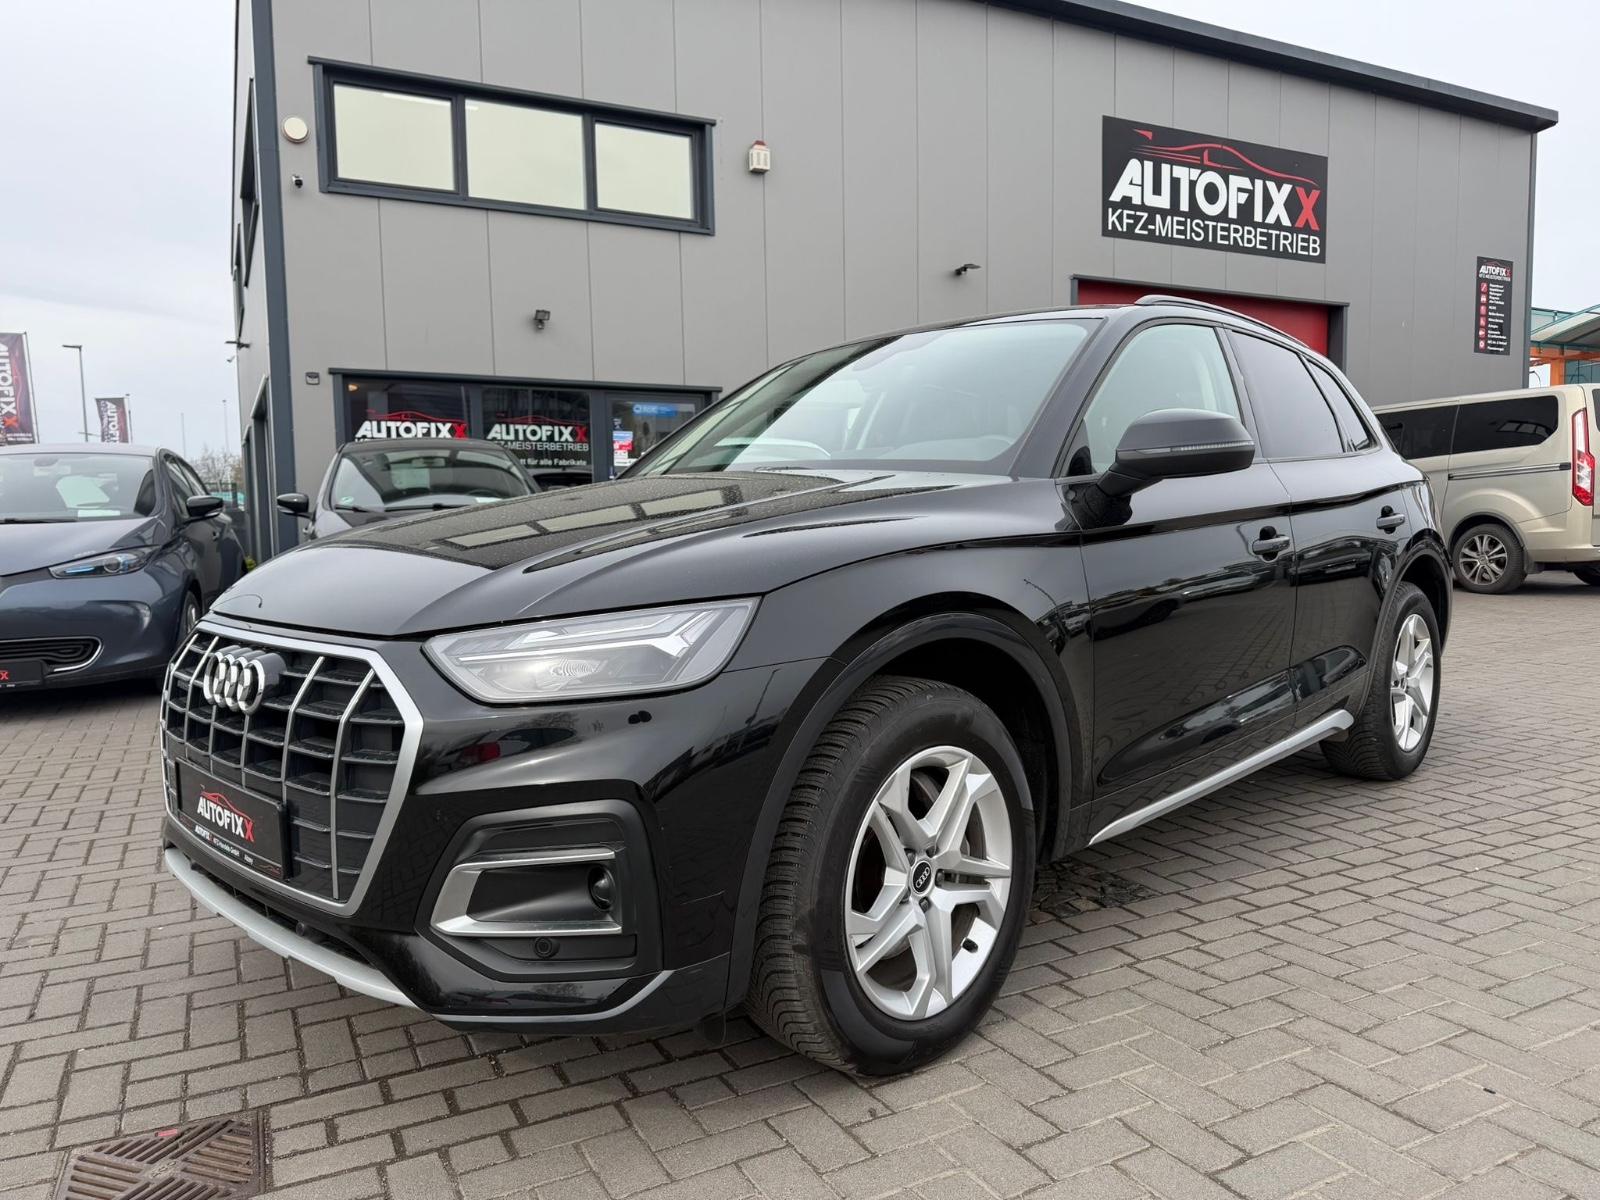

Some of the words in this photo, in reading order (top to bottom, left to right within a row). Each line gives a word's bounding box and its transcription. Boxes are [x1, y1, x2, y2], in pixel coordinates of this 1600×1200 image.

[1108, 158, 1321, 231] AUTOFIXX
[1107, 207, 1321, 257] KFZ-MEISTERBETRIEB
[354, 420, 468, 441] AUTOFIXX
[486, 423, 588, 442] AUTOFIXX
[494, 440, 589, 452] Z-MEISTERBETRIEB
[196, 796, 255, 842] AUTOFIXX
